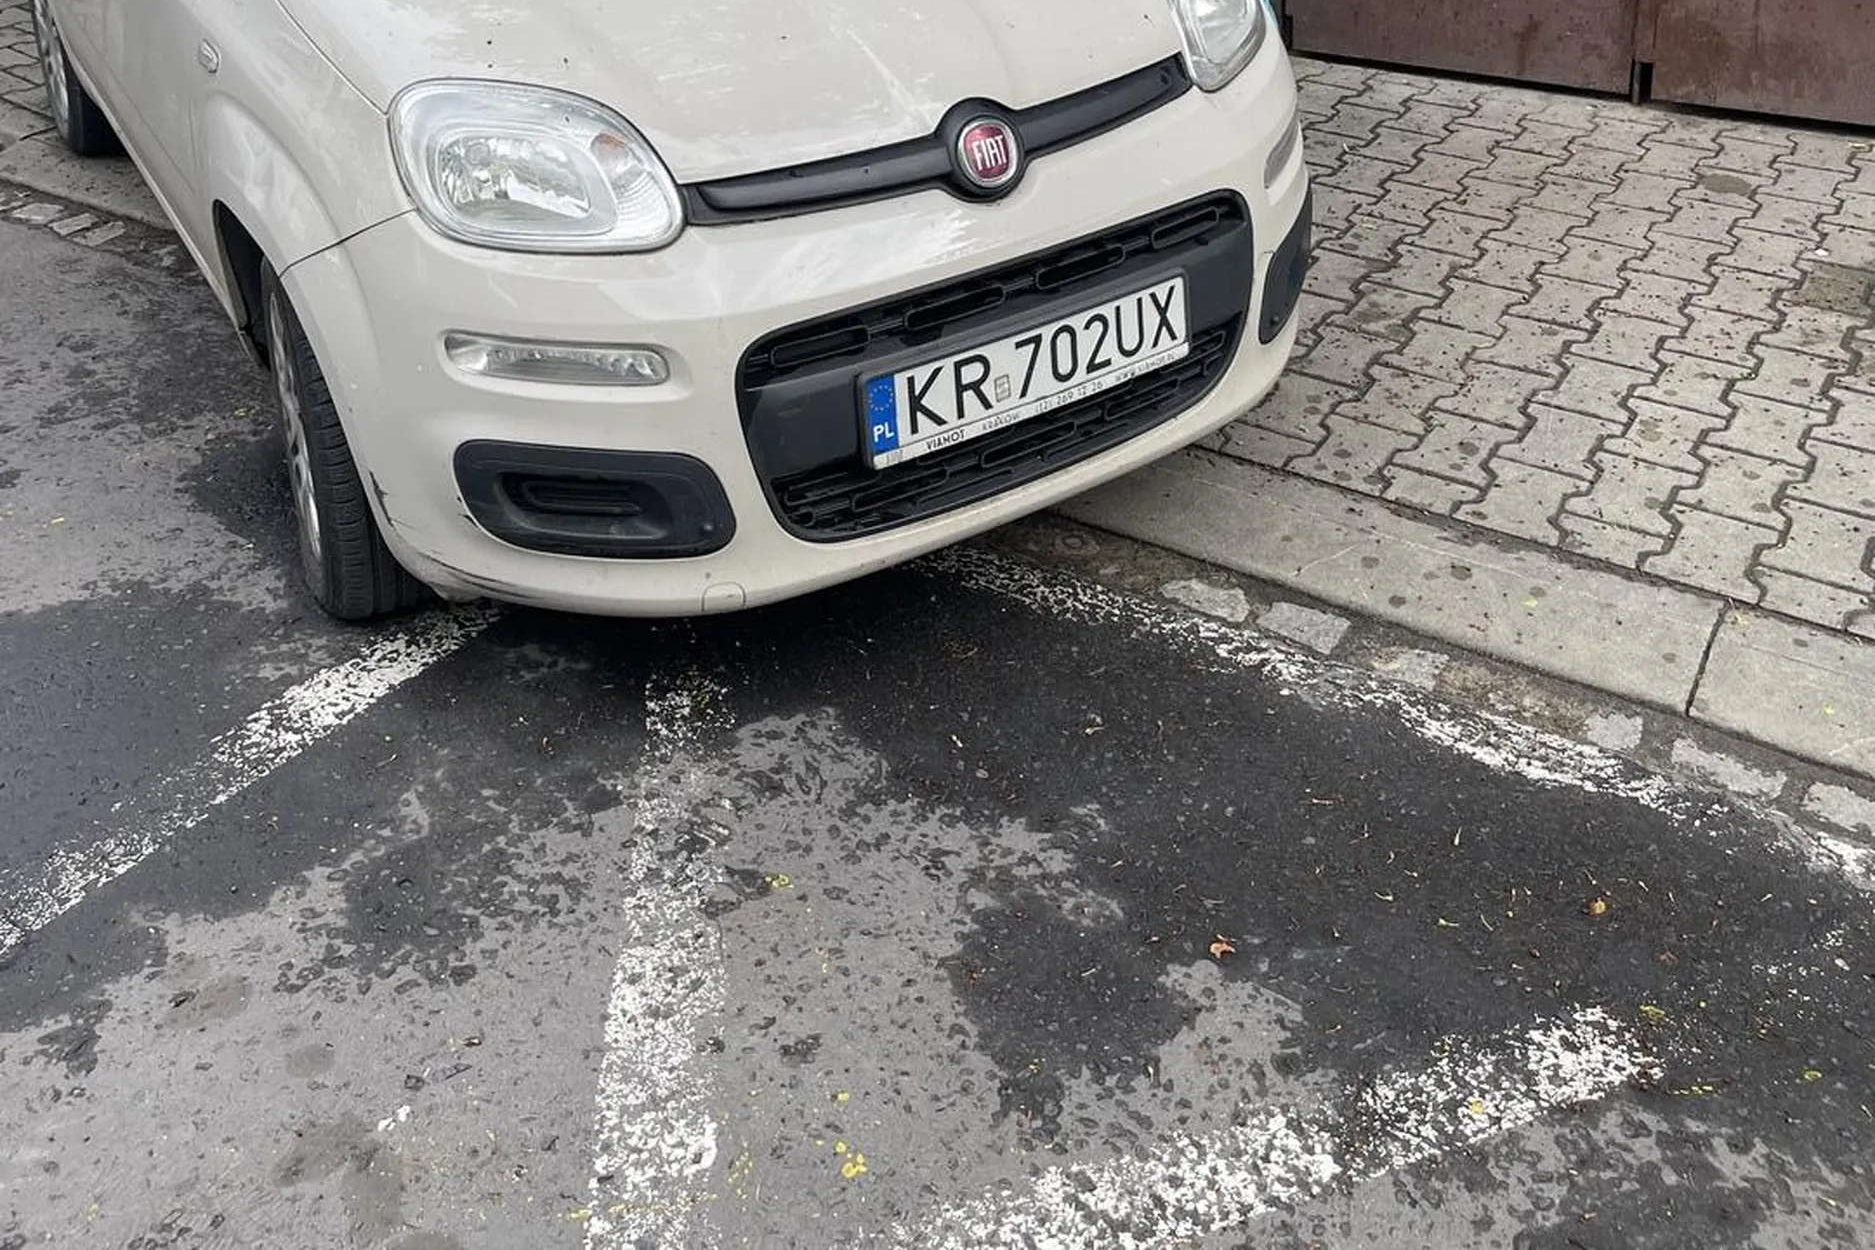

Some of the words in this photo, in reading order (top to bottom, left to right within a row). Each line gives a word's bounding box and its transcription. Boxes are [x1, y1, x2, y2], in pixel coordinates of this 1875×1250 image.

[971, 135, 1007, 171] FIAT
[906, 354, 993, 435] KR
[1015, 285, 1178, 399] 702UX
[873, 423, 894, 442] PL
[926, 428, 966, 451] VIAMOT
